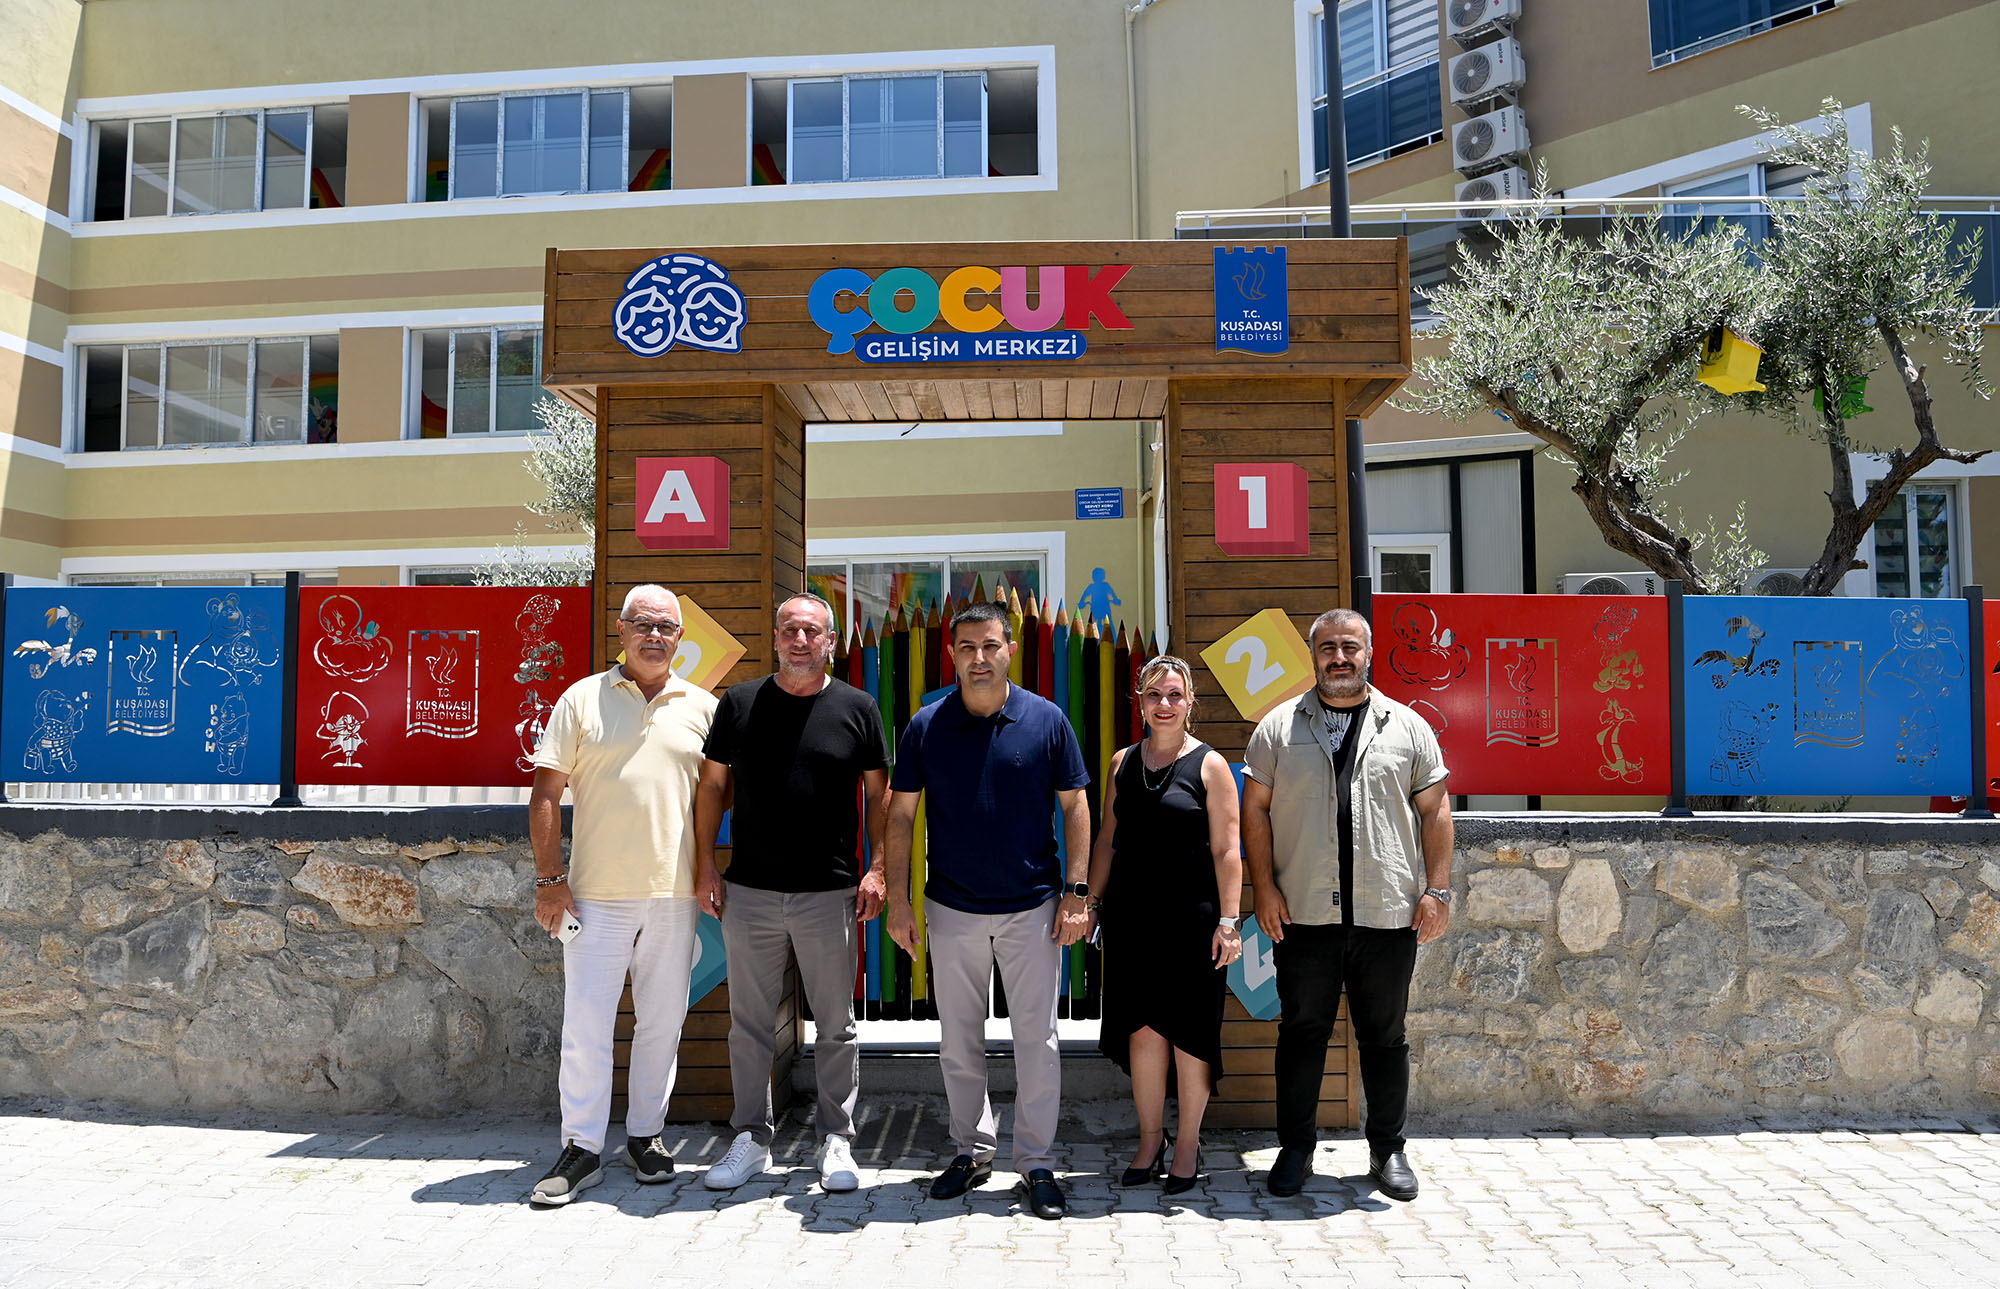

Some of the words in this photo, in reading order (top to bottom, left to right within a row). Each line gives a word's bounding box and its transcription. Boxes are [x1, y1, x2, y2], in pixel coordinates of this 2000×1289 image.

[808, 265, 1135, 354] ÇOCUK
[1243, 310, 1260, 318] T.C.
[1220, 321, 1282, 331] KUŞADASI
[1220, 332, 1282, 341] BELEDİYESİ
[866, 336, 959, 361] GELİŞİM
[974, 335, 1077, 356] MERKEZİ
[644, 470, 706, 523] A
[1239, 476, 1267, 528] 1
[1645, 577, 1655, 596] elik
[1225, 636, 1285, 696] 2
[115, 699, 169, 709] KUŞADASI
[416, 700, 471, 712] KUŞADASI
[115, 709, 169, 719] BELEDİYESİ
[416, 710, 471, 720] BELEDİYESİ
[1496, 709, 1551, 720] KUŞADASI
